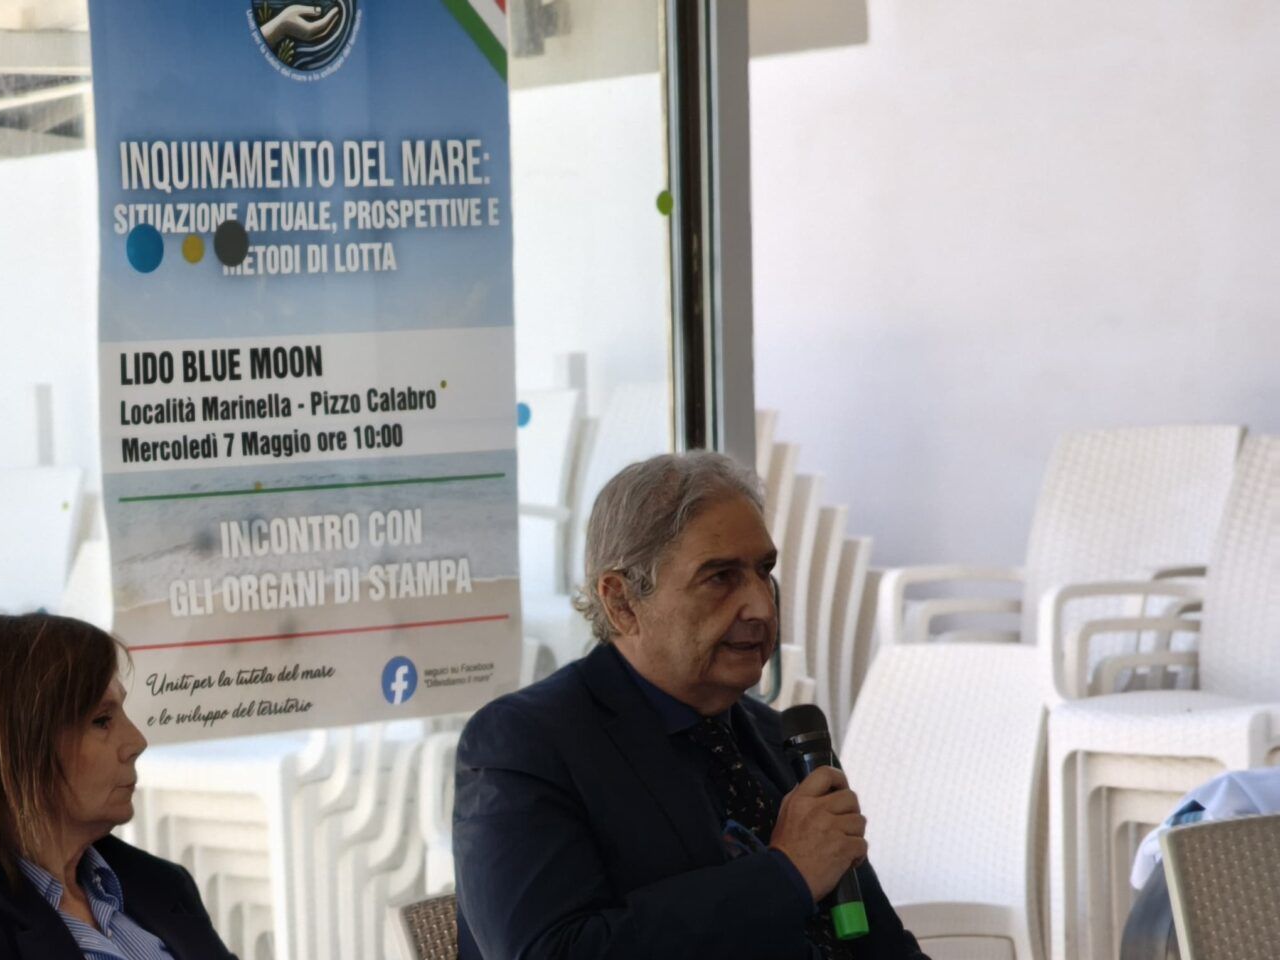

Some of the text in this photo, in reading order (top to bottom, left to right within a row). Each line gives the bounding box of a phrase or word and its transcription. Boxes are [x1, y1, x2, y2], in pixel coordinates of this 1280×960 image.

[119, 139, 491, 194] INQUINAMENTO DEL MARE:
[245, 201, 338, 235] ATTUALE,
[343, 198, 482, 230] PROSPETTIVE
[488, 197, 500, 226] E
[222, 242, 397, 276] ETODI DI LOTTA
[120, 345, 323, 386] LIDO BLUE MOON
[120, 397, 195, 426] Località
[202, 393, 292, 422] Marinella
[310, 390, 361, 417] Pizzo
[366, 386, 437, 413] Calabro
[121, 423, 403, 463] Mercoledì 7 Maggio ore 10:00
[220, 508, 422, 559] INCONTRO CON
[169, 557, 472, 617] GLI ORGANI DI STAMPA
[146, 664, 336, 697] Uniti per la tutela del mare
[147, 697, 313, 728] e lo sviluppo del territorio
